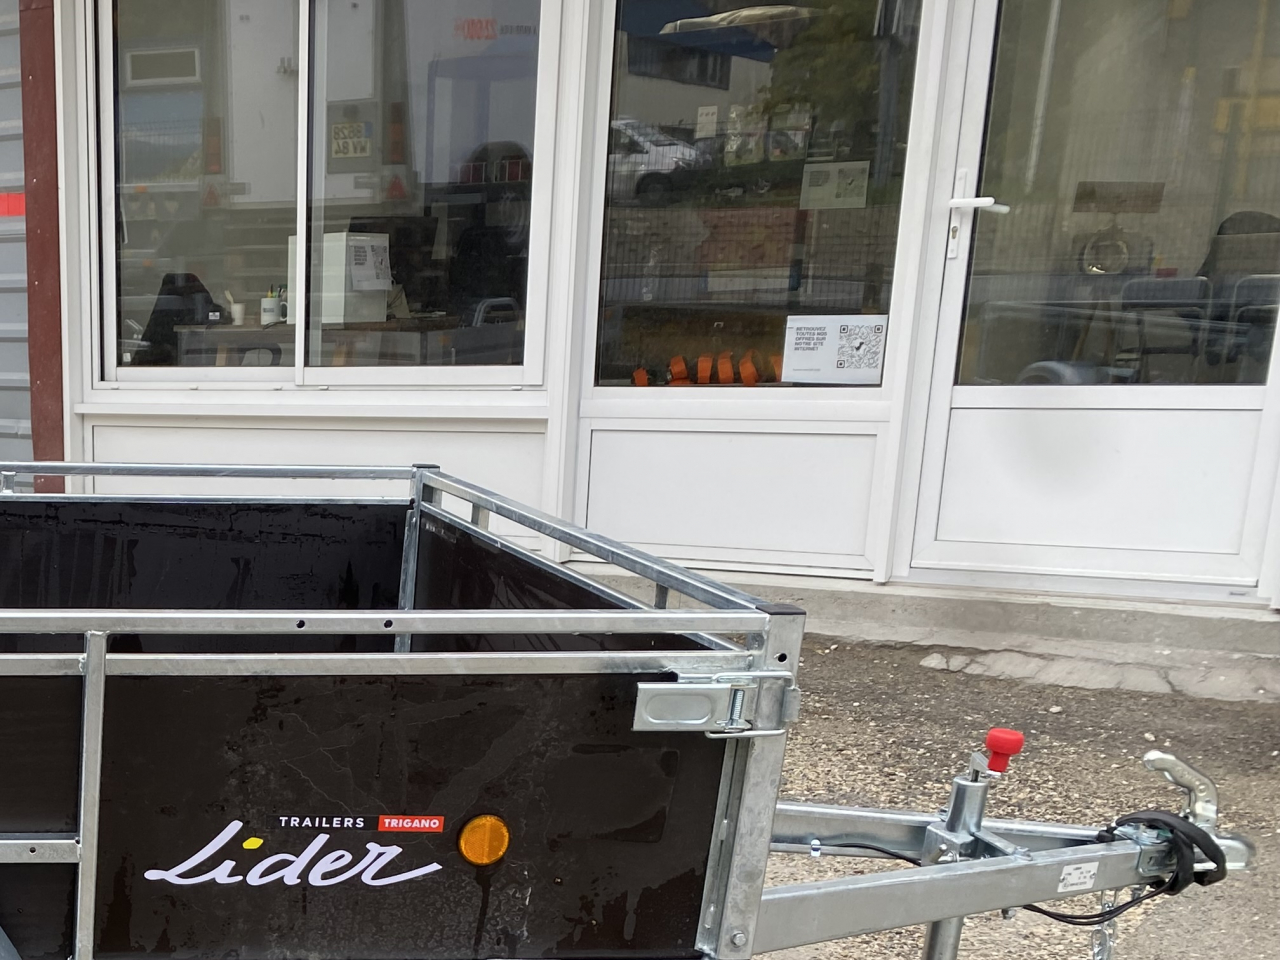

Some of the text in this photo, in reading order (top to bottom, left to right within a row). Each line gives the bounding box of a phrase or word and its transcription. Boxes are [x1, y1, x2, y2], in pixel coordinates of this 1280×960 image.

[279, 816, 440, 829] TRAILERS TRIGANO
[144, 819, 443, 887] Lider
